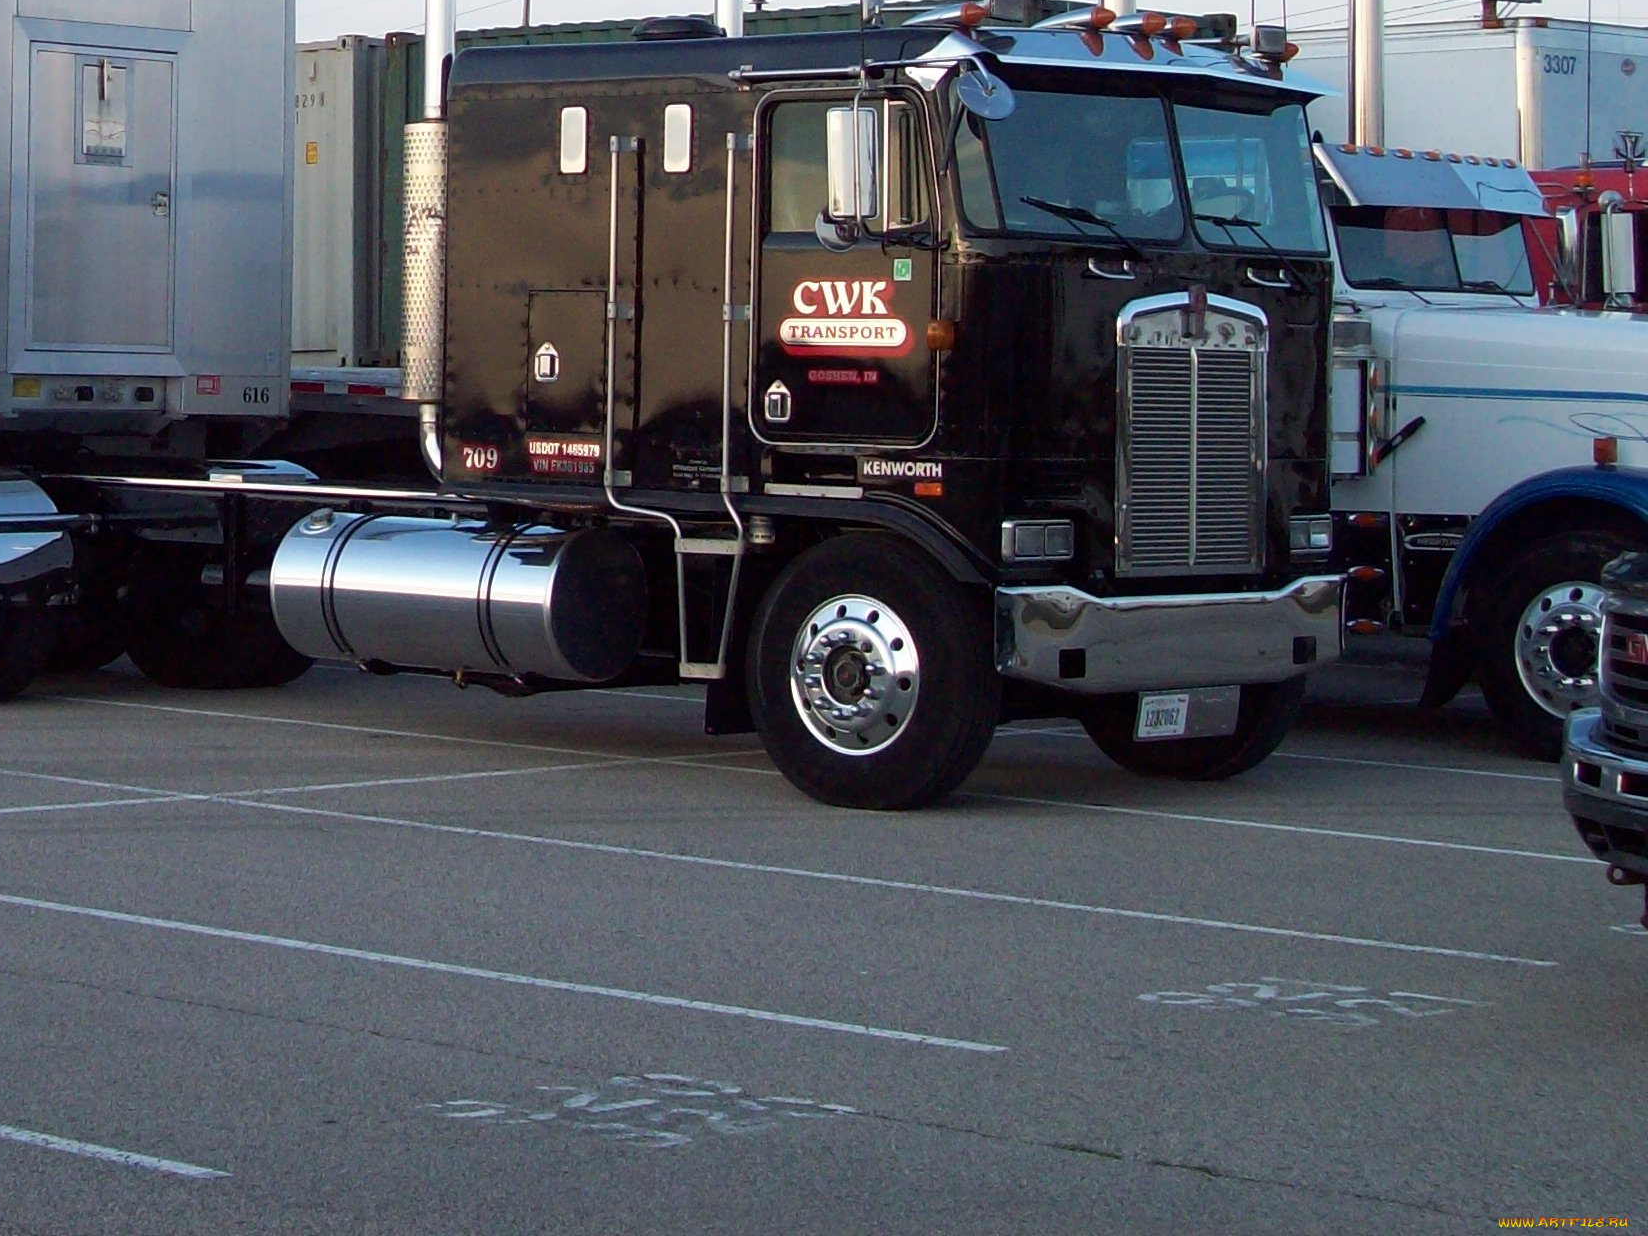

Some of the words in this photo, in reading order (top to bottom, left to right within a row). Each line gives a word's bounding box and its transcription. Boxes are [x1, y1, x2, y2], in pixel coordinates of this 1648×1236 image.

[1543, 54, 1577, 75] 3307
[793, 281, 888, 315] CWK
[788, 325, 898, 339] TRANSPORT
[863, 370, 878, 381] IN
[242, 386, 270, 404] 616
[529, 441, 560, 455] USDOT
[463, 447, 498, 468] 709
[533, 459, 549, 472] VIN
[863, 461, 942, 477] KENWORTH
